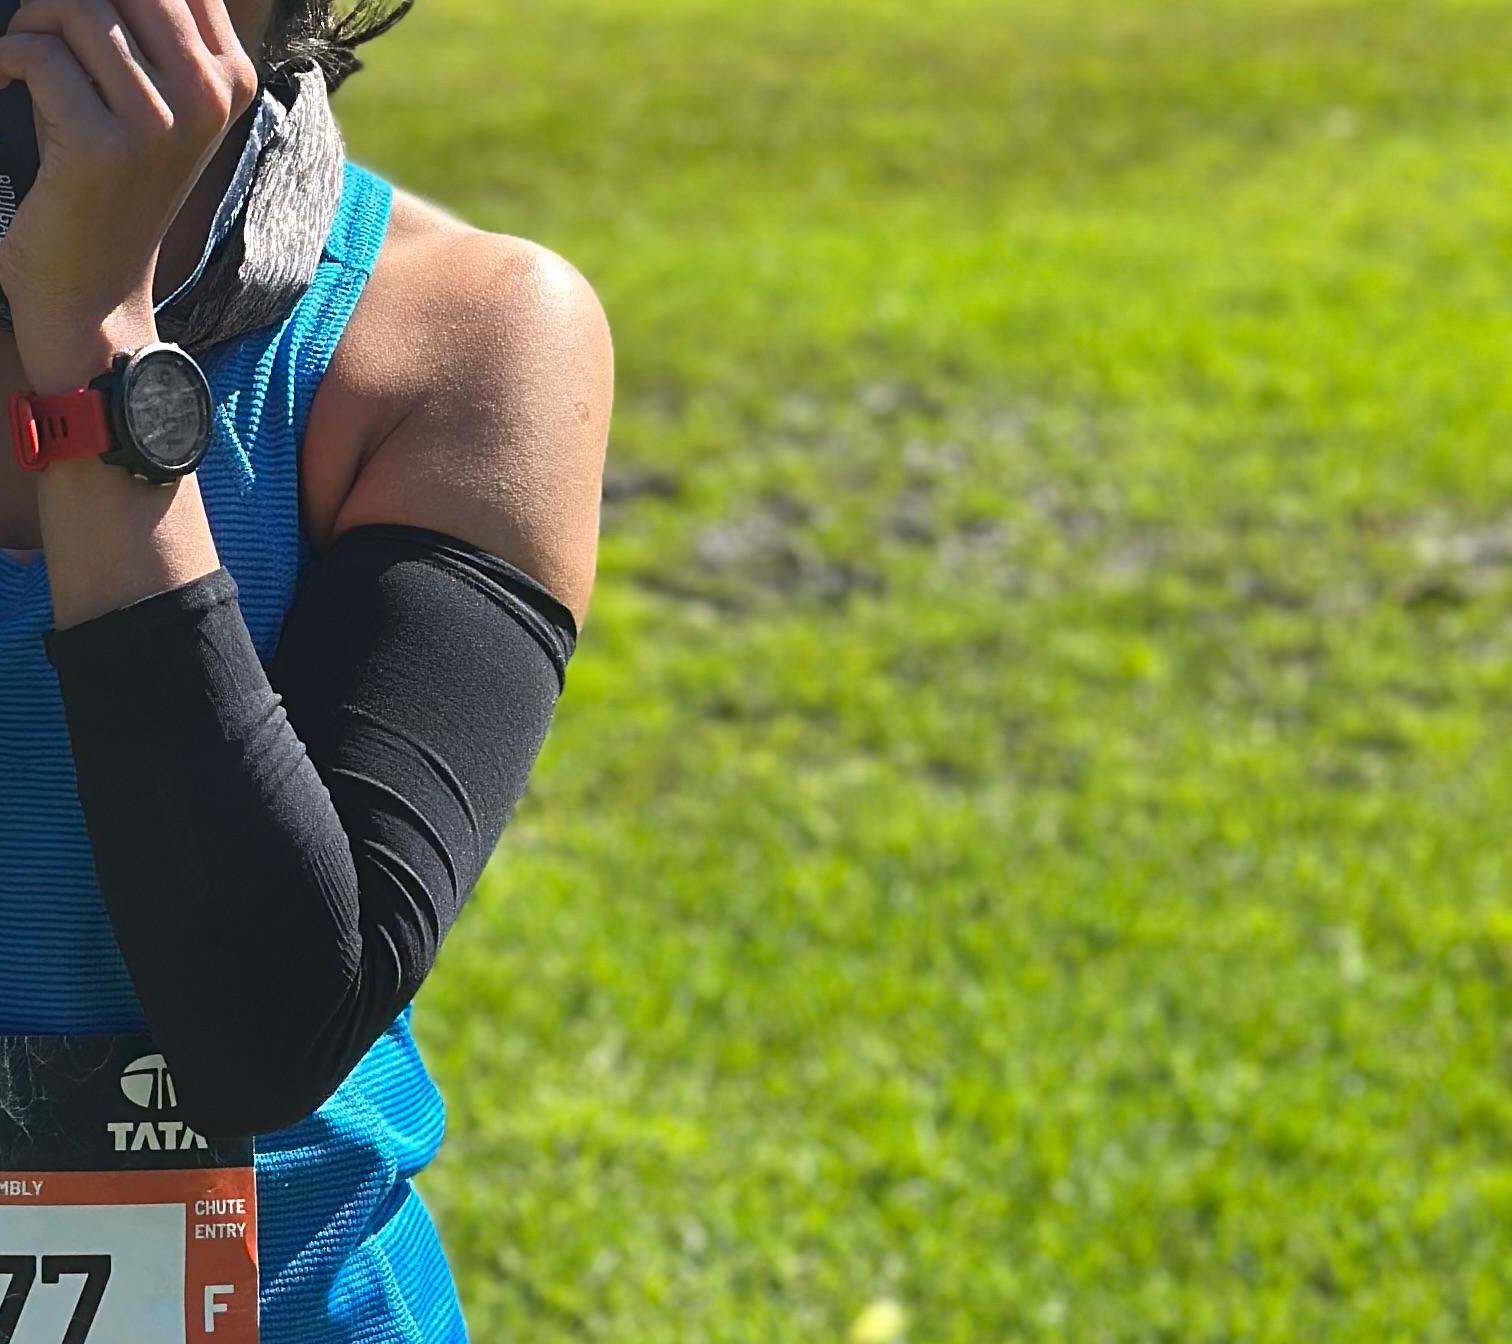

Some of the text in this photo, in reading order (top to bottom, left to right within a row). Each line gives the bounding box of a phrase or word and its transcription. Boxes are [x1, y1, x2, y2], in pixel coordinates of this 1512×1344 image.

[107, 1121, 208, 1151] TATA
[194, 1199, 247, 1216] CHUTE
[194, 1222, 247, 1239] ENTRY
[204, 1284, 235, 1333] F
